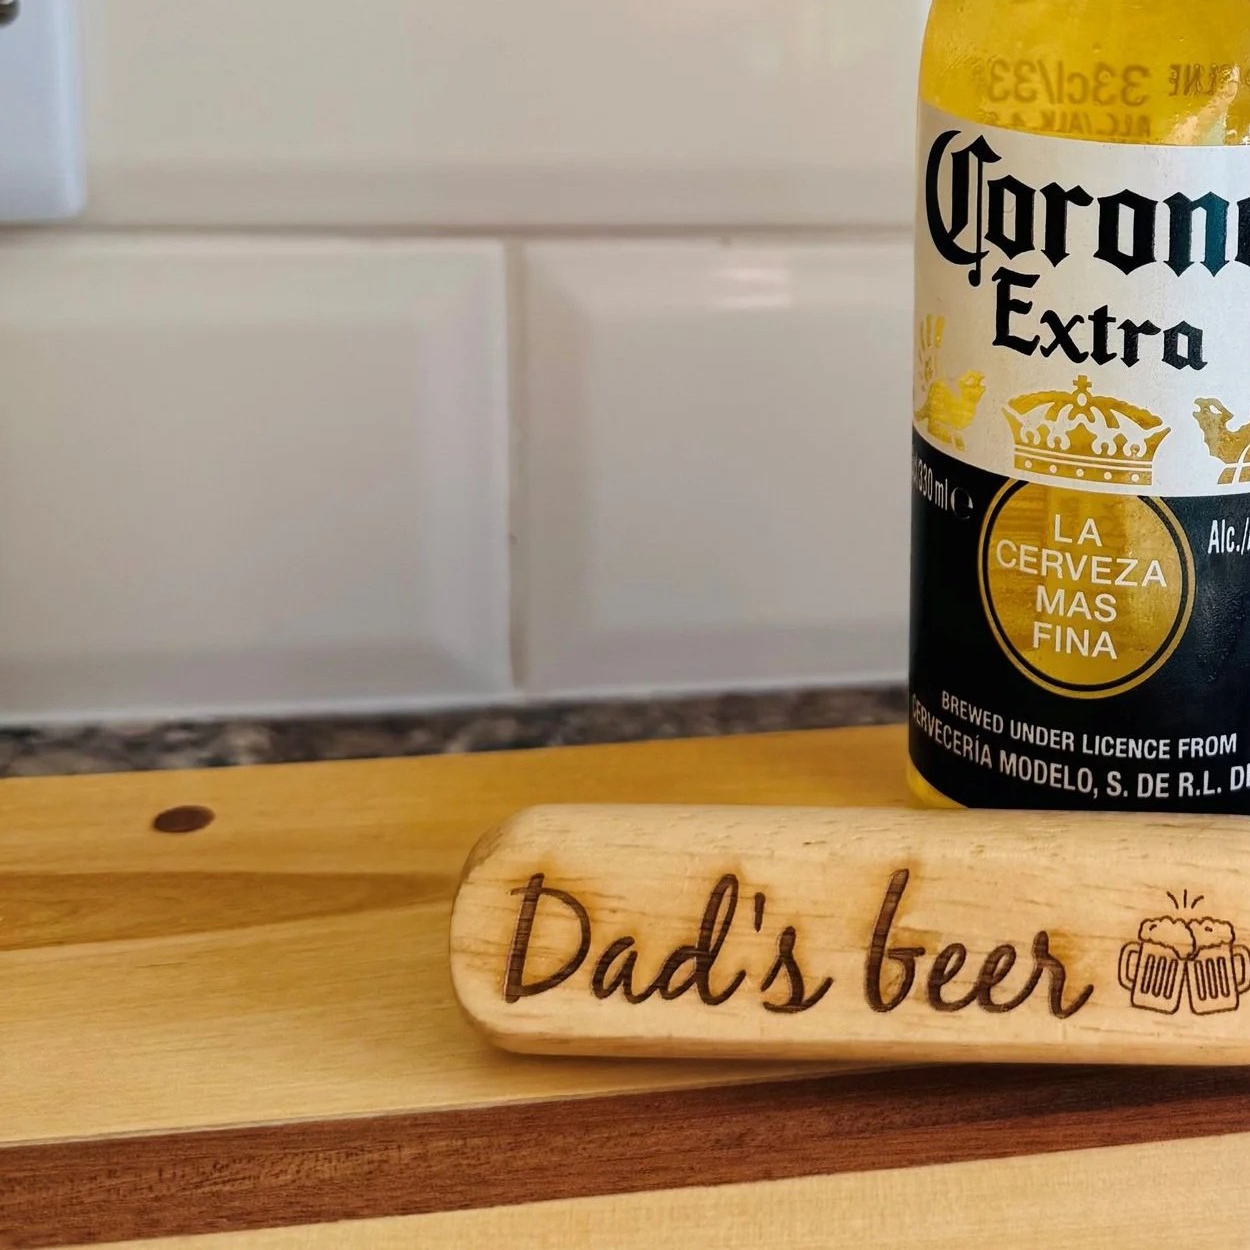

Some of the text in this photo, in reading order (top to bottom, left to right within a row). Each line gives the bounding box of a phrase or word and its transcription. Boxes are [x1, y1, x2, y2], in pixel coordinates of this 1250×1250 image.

[991, 266, 1208, 371] Extra
[1054, 514, 1102, 547] LA
[996, 539, 1168, 587] CERVEZA
[1036, 585, 1117, 622] MAS
[1033, 621, 1118, 660] FINA
[941, 690, 1238, 759] BREWED UNDER LICENCE FROM
[999, 750, 1099, 799] MODELO,
[1106, 770, 1128, 797] S.
[1137, 773, 1170, 798] DE
[1178, 770, 1222, 798] R.L.
[504, 868, 1095, 1020] Dad's beer
